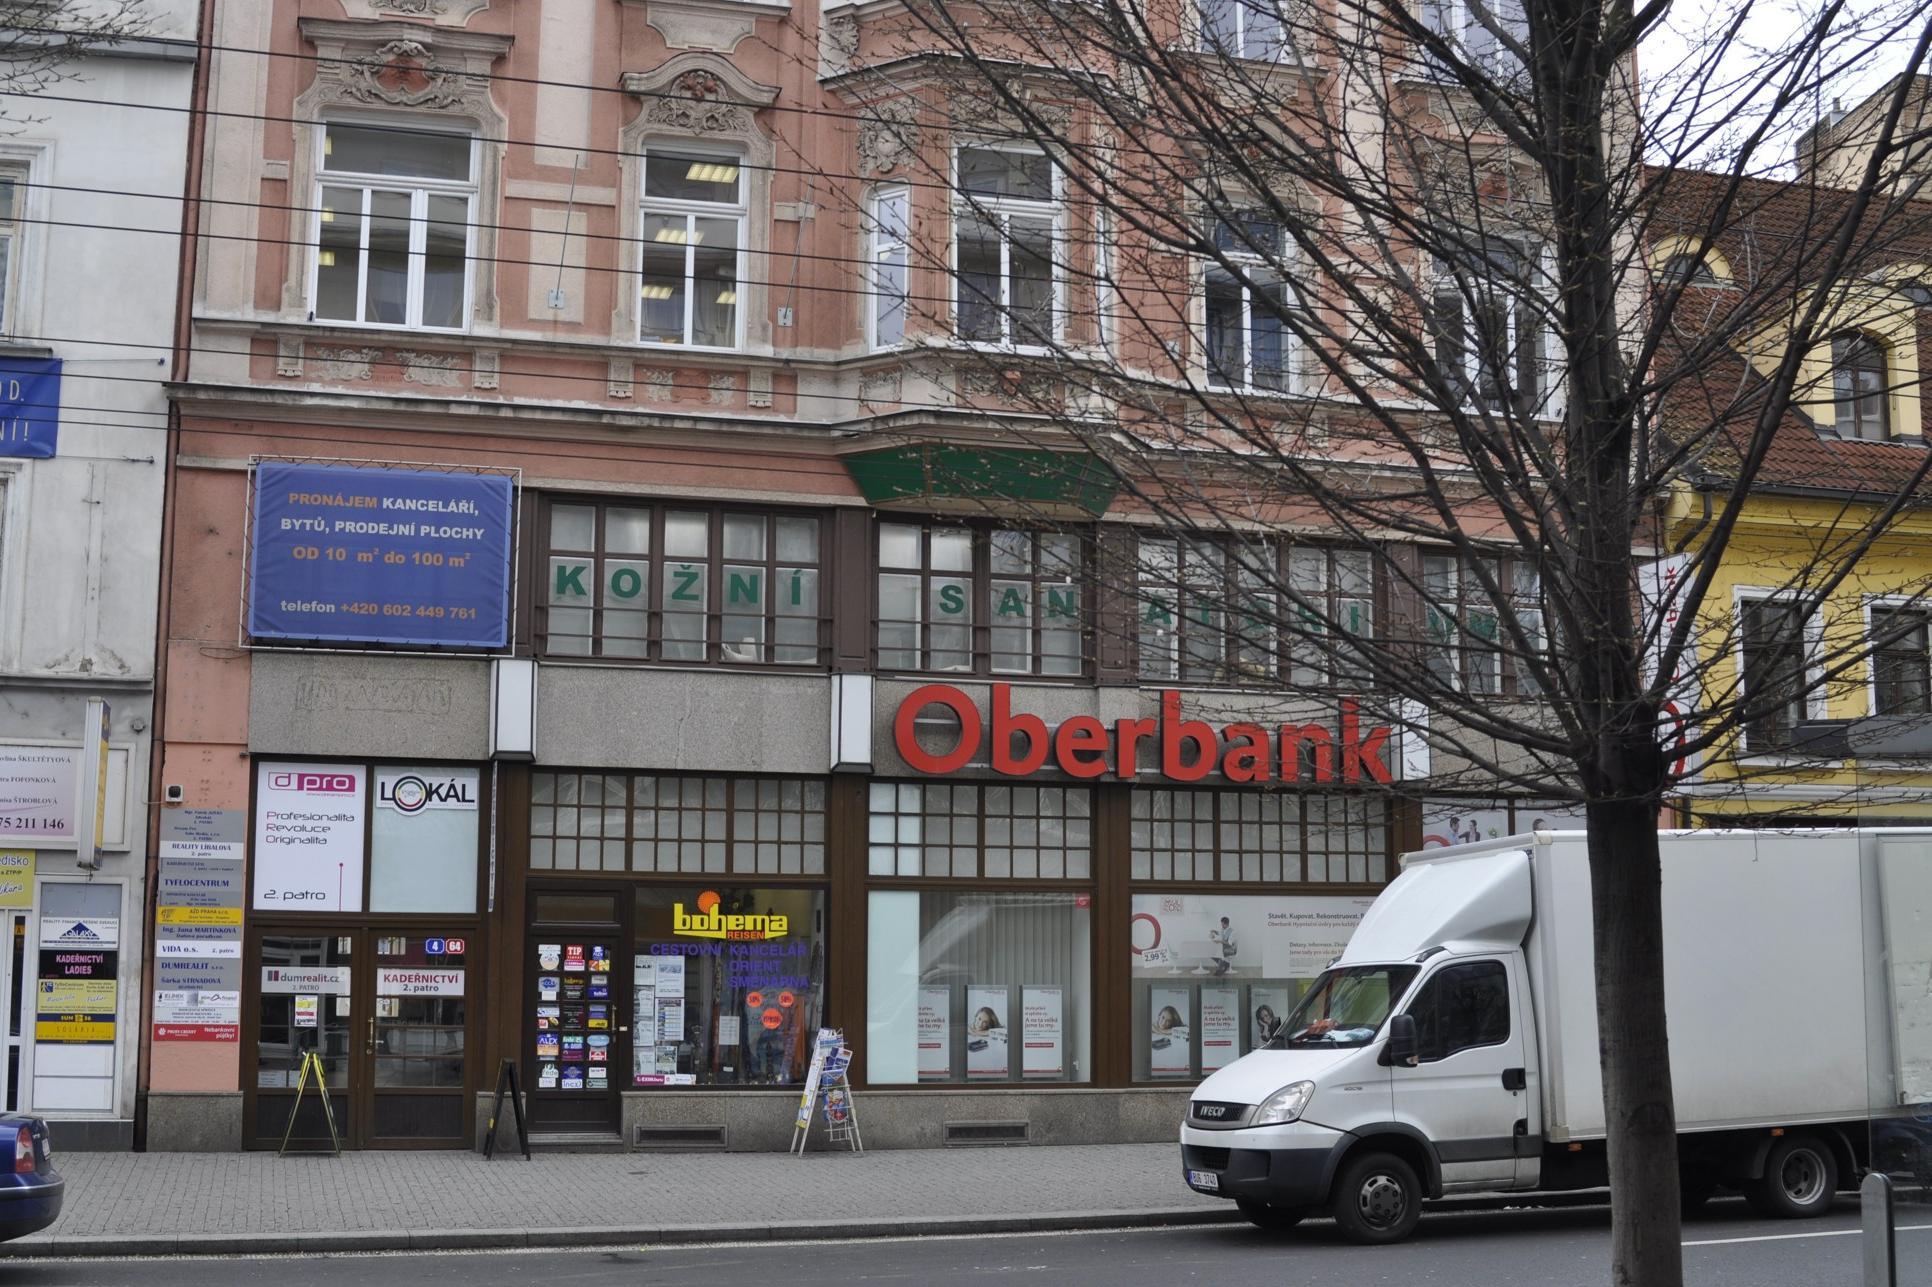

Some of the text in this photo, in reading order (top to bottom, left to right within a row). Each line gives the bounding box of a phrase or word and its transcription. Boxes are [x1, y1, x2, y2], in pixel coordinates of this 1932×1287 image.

[288, 492, 479, 516] PRONÁJEM KANCELÁŘÍ,
[281, 516, 485, 540] BYTŮ, PRODEJNÍ PLOCHY
[293, 547, 319, 560] OD
[325, 548, 346, 561] 10
[384, 551, 405, 565] do
[412, 552, 444, 566] 100
[556, 564, 803, 606] KOŽNÍ
[281, 600, 477, 620] telefon +420 602 449 761
[894, 683, 1393, 784] Oberbank
[381, 776, 475, 812] LOKÁL
[266, 811, 355, 822] Profesionalita
[16, 817, 36, 829] 211
[43, 818, 65, 830] 146
[266, 823, 331, 833] Revoluce
[265, 835, 327, 845] Originalita
[164, 879, 230, 887] TYFLOCENTRUM
[264, 890, 326, 901] 2. patro
[673, 903, 788, 935] bohema
[727, 931, 765, 939] REISEN
[162, 945, 182, 953] VIDA
[432, 941, 439, 951] 4
[449, 941, 461, 951] 64
[56, 953, 103, 963] KADEŘNICTVÍ
[65, 965, 92, 975] LADIES
[280, 972, 340, 983] dumrealit.cz
[383, 973, 459, 984] KADEŘNICTVÍ
[413, 984, 439, 993] patro
[1200, 1105, 1225, 1117] IVECO
